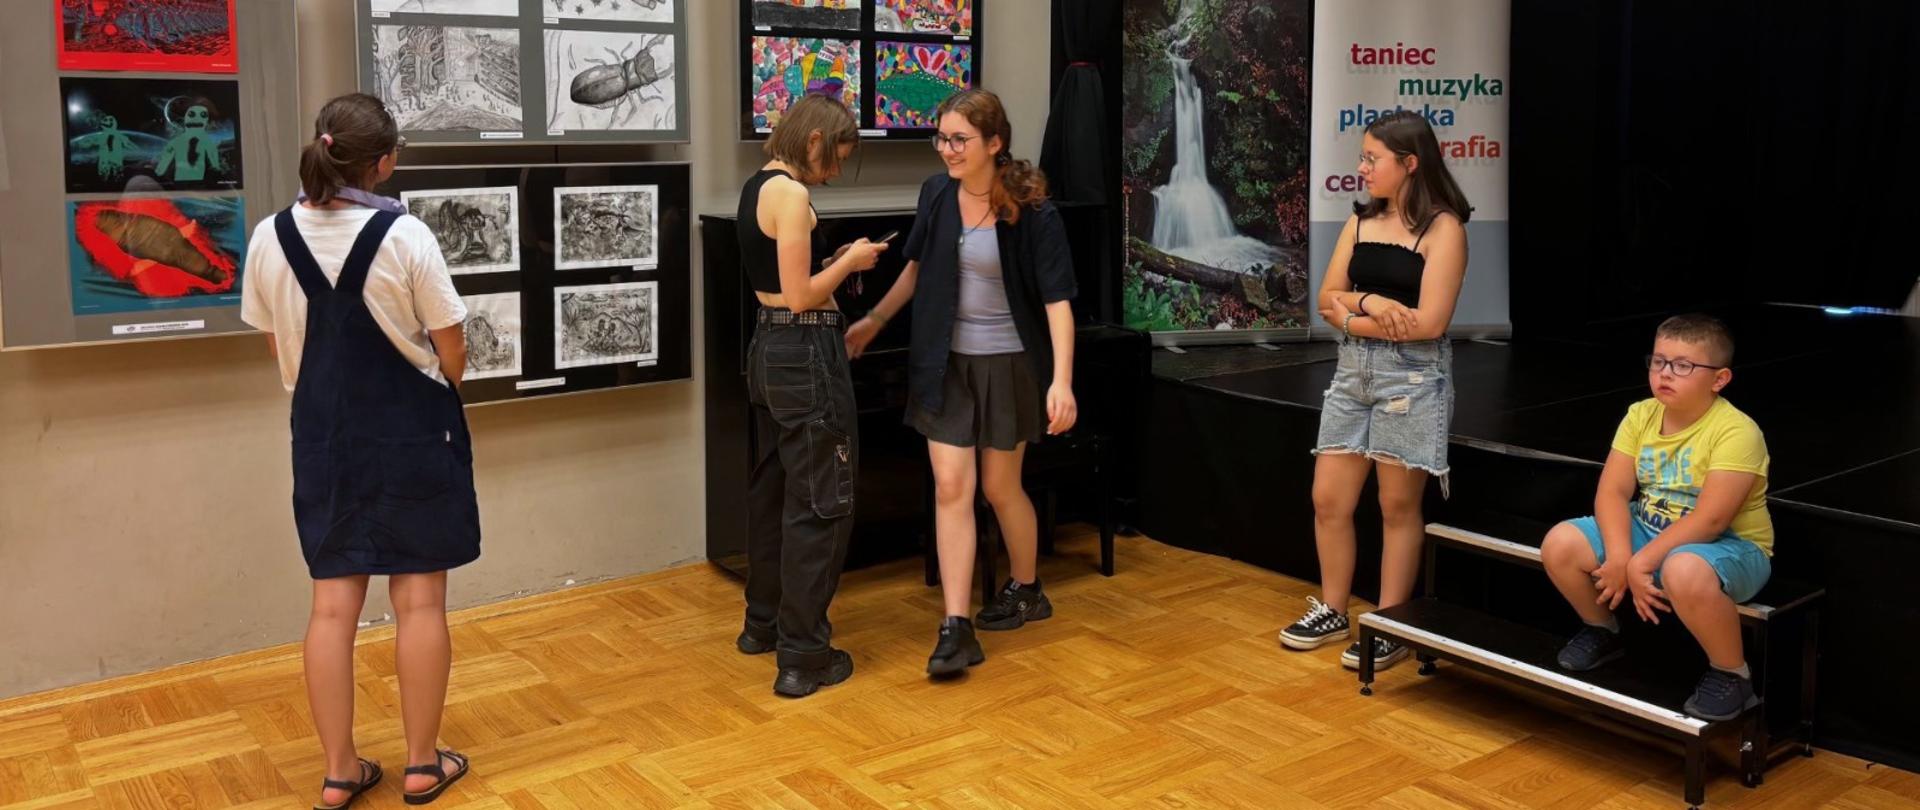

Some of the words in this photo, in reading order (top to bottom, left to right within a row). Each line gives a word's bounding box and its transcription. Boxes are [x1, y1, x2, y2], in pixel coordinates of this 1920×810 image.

[1351, 42, 1436, 65] taniec
[1399, 73, 1503, 101] muzyka
[1339, 104, 1455, 132] plastka
[1440, 135, 1501, 158] rafia
[1325, 174, 1365, 192] cer
